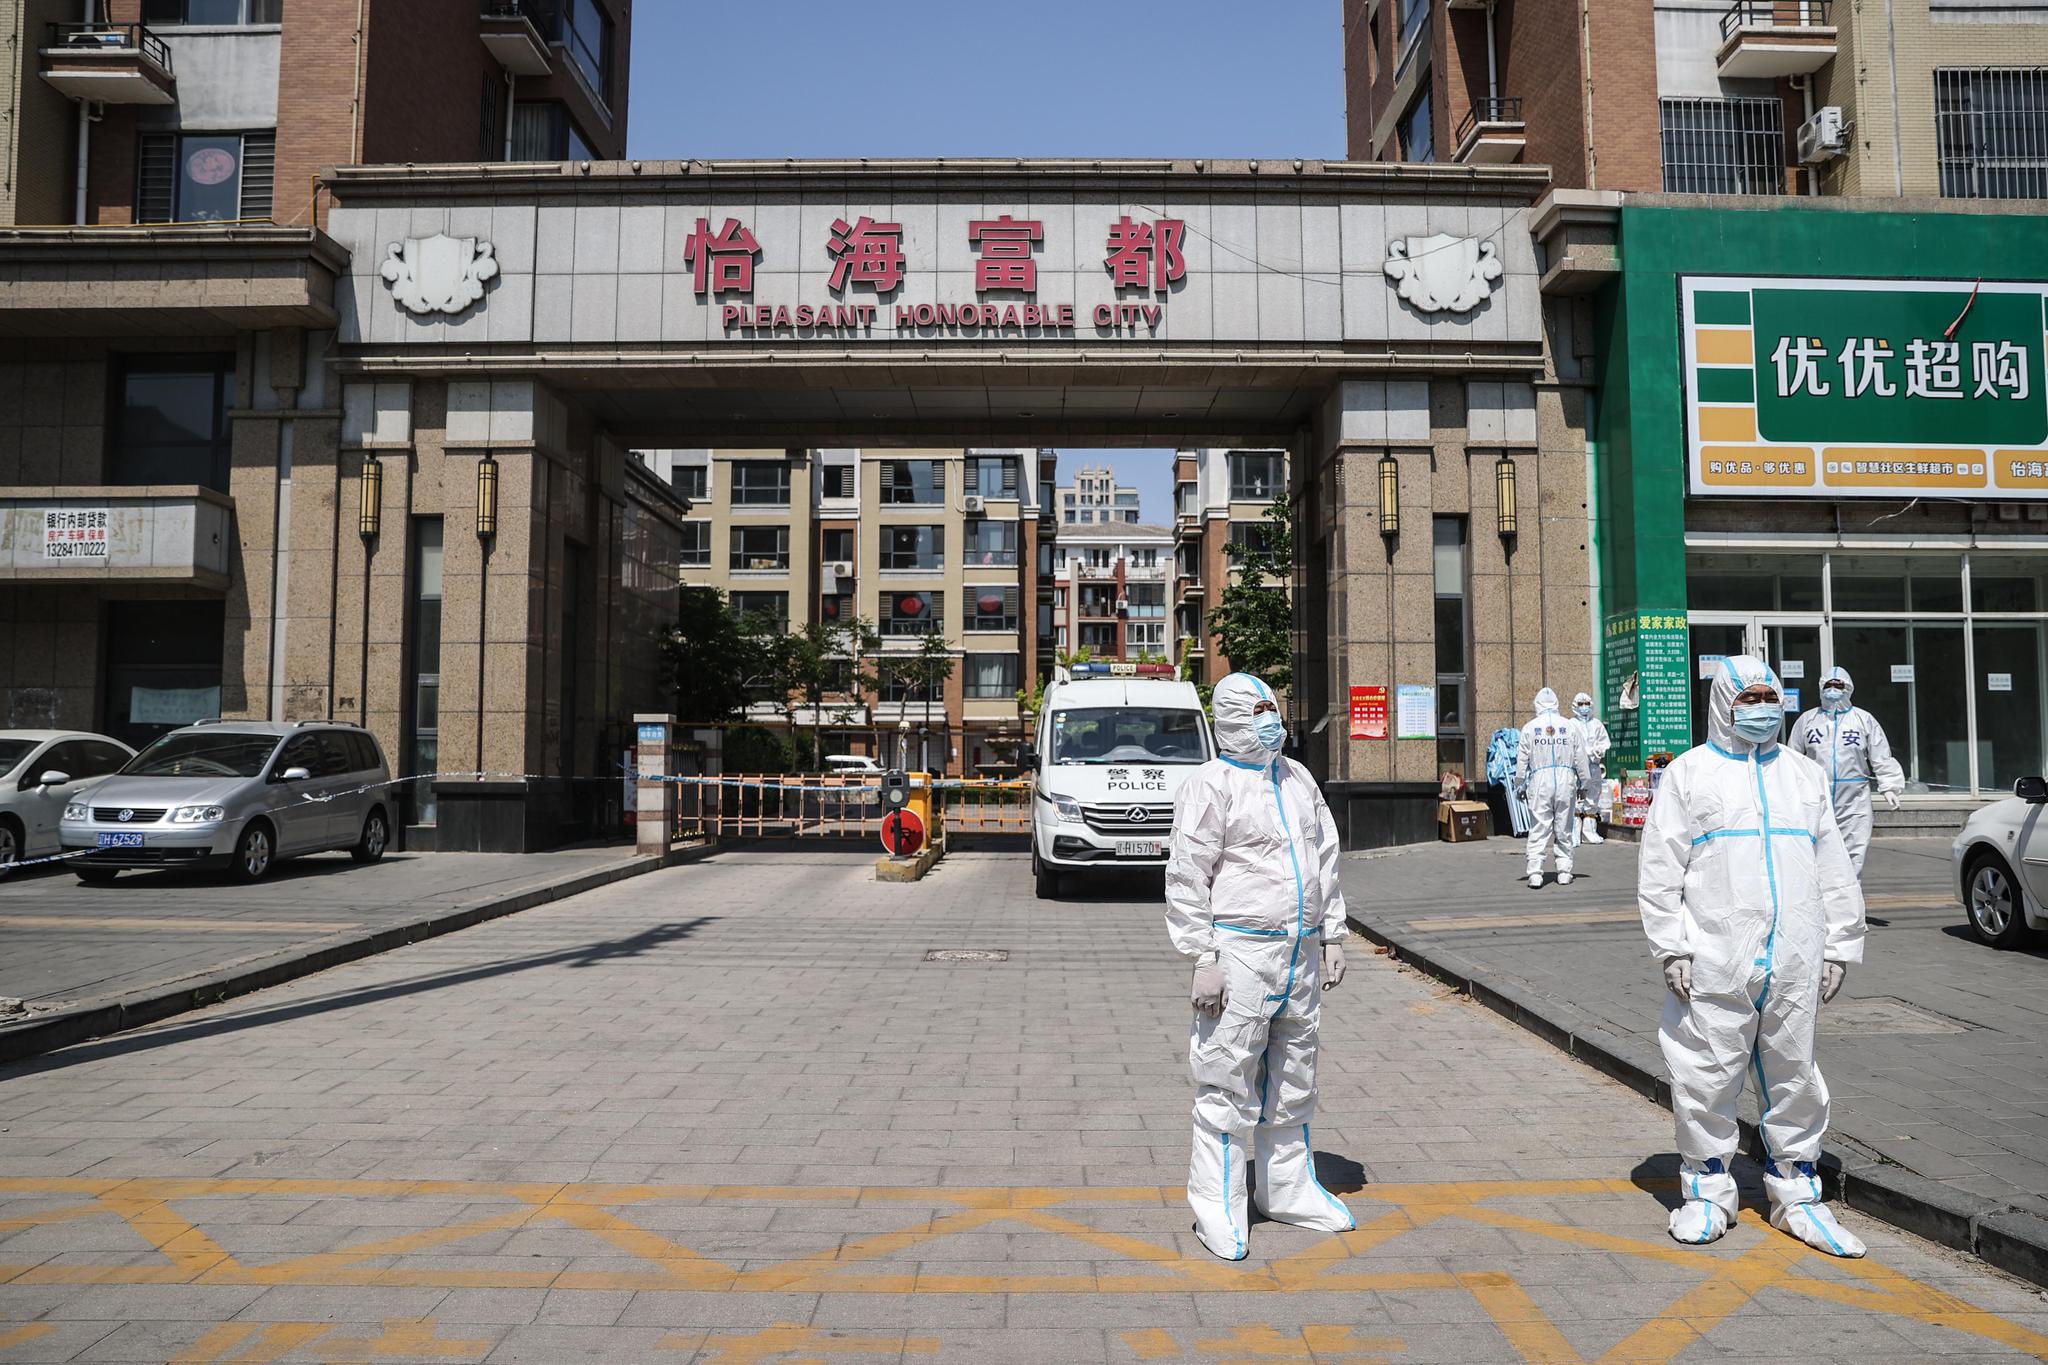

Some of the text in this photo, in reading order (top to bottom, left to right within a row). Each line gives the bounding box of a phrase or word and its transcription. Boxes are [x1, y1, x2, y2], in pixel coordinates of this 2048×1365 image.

[684, 215, 1186, 292] 怡海富都
[723, 304, 1161, 327] PLEASANT HONORABLE CITY
[1770, 336, 2030, 400] 优优超购
[1855, 461, 1954, 475] 智慧社区生鲜超市
[2010, 461, 2048, 478] 怡海
[47, 512, 107, 528] 银行内部贷款
[48, 530, 64, 541] 房产
[88, 529, 105, 541] 保单
[46, 542, 106, 557] 13284170222
[1639, 616, 1687, 629] 爱家家政
[1534, 738, 1568, 746] POLICE
[1807, 728, 1861, 746] 公安
[1107, 781, 1167, 791] POLICE
